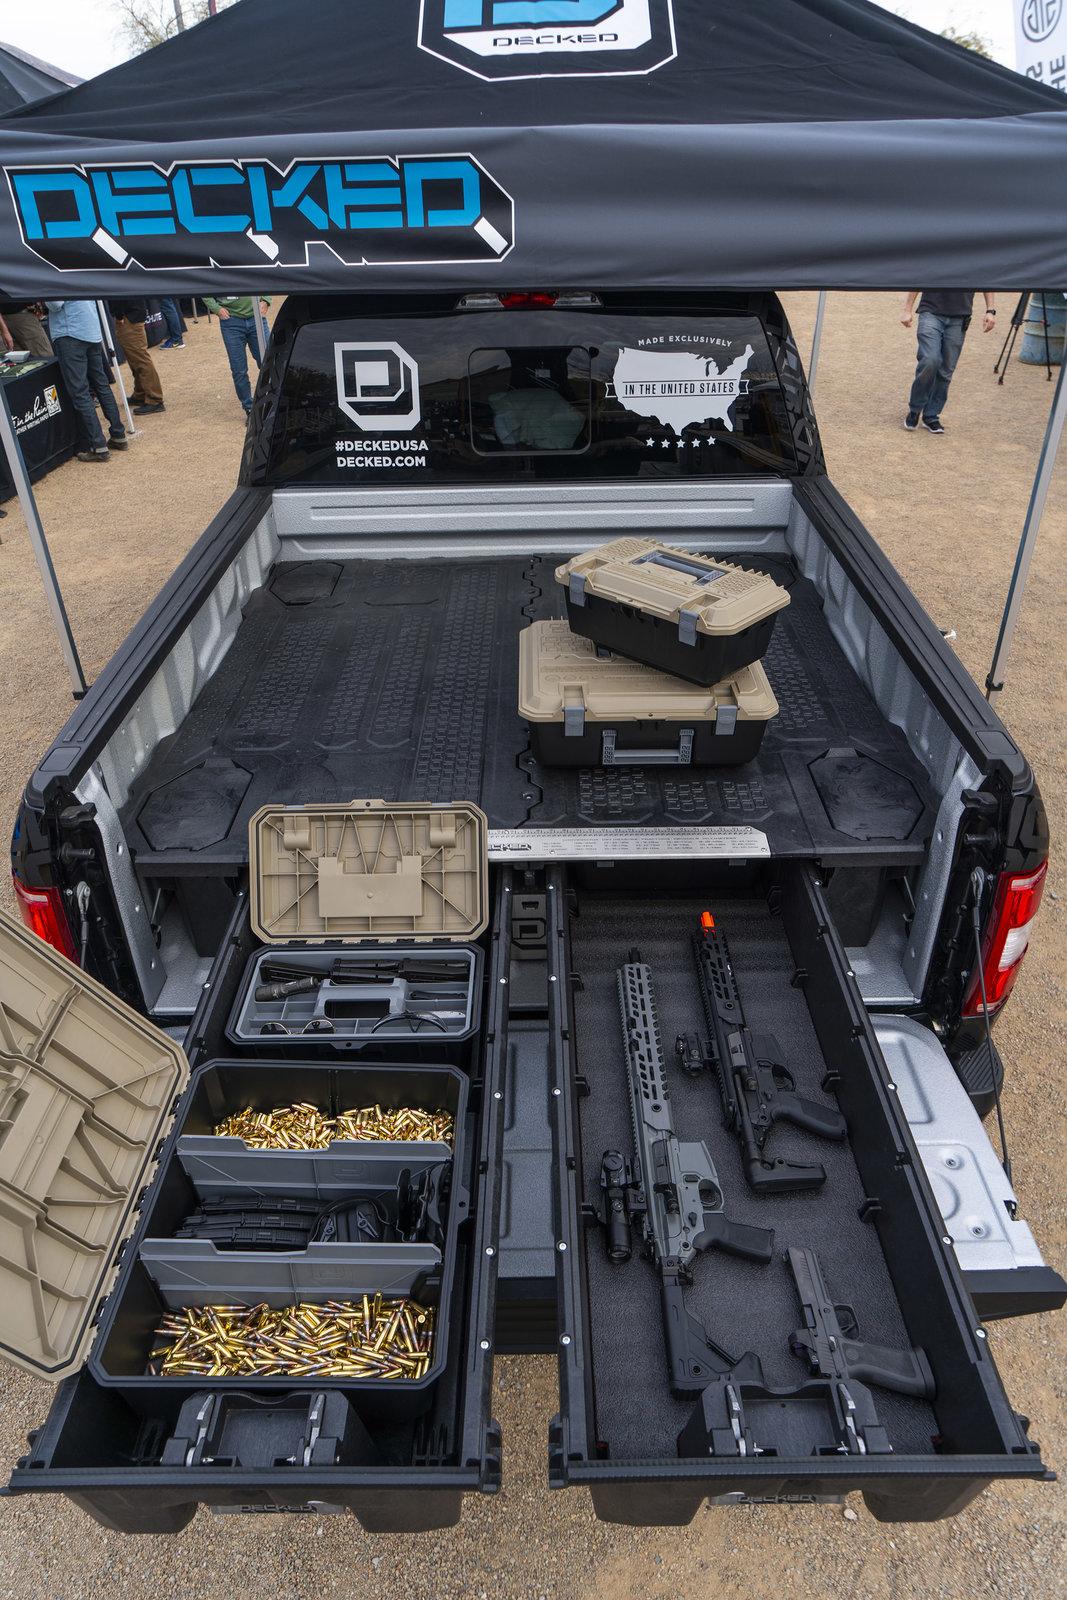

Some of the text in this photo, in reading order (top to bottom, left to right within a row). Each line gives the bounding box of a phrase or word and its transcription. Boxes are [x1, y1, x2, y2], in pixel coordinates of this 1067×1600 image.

[493, 33, 618, 47] DECKED
[12, 160, 482, 240] DECKED
[638, 335, 733, 347] MADE EXCLUSIVELY
[625, 382, 734, 395] IN THE UNITED STATES
[335, 440, 429, 451] #DECKEDUSA
[337, 456, 426, 467] DECKED.COM
[738, 1494, 813, 1504] DECKED
[240, 1504, 315, 1513] DECKED
